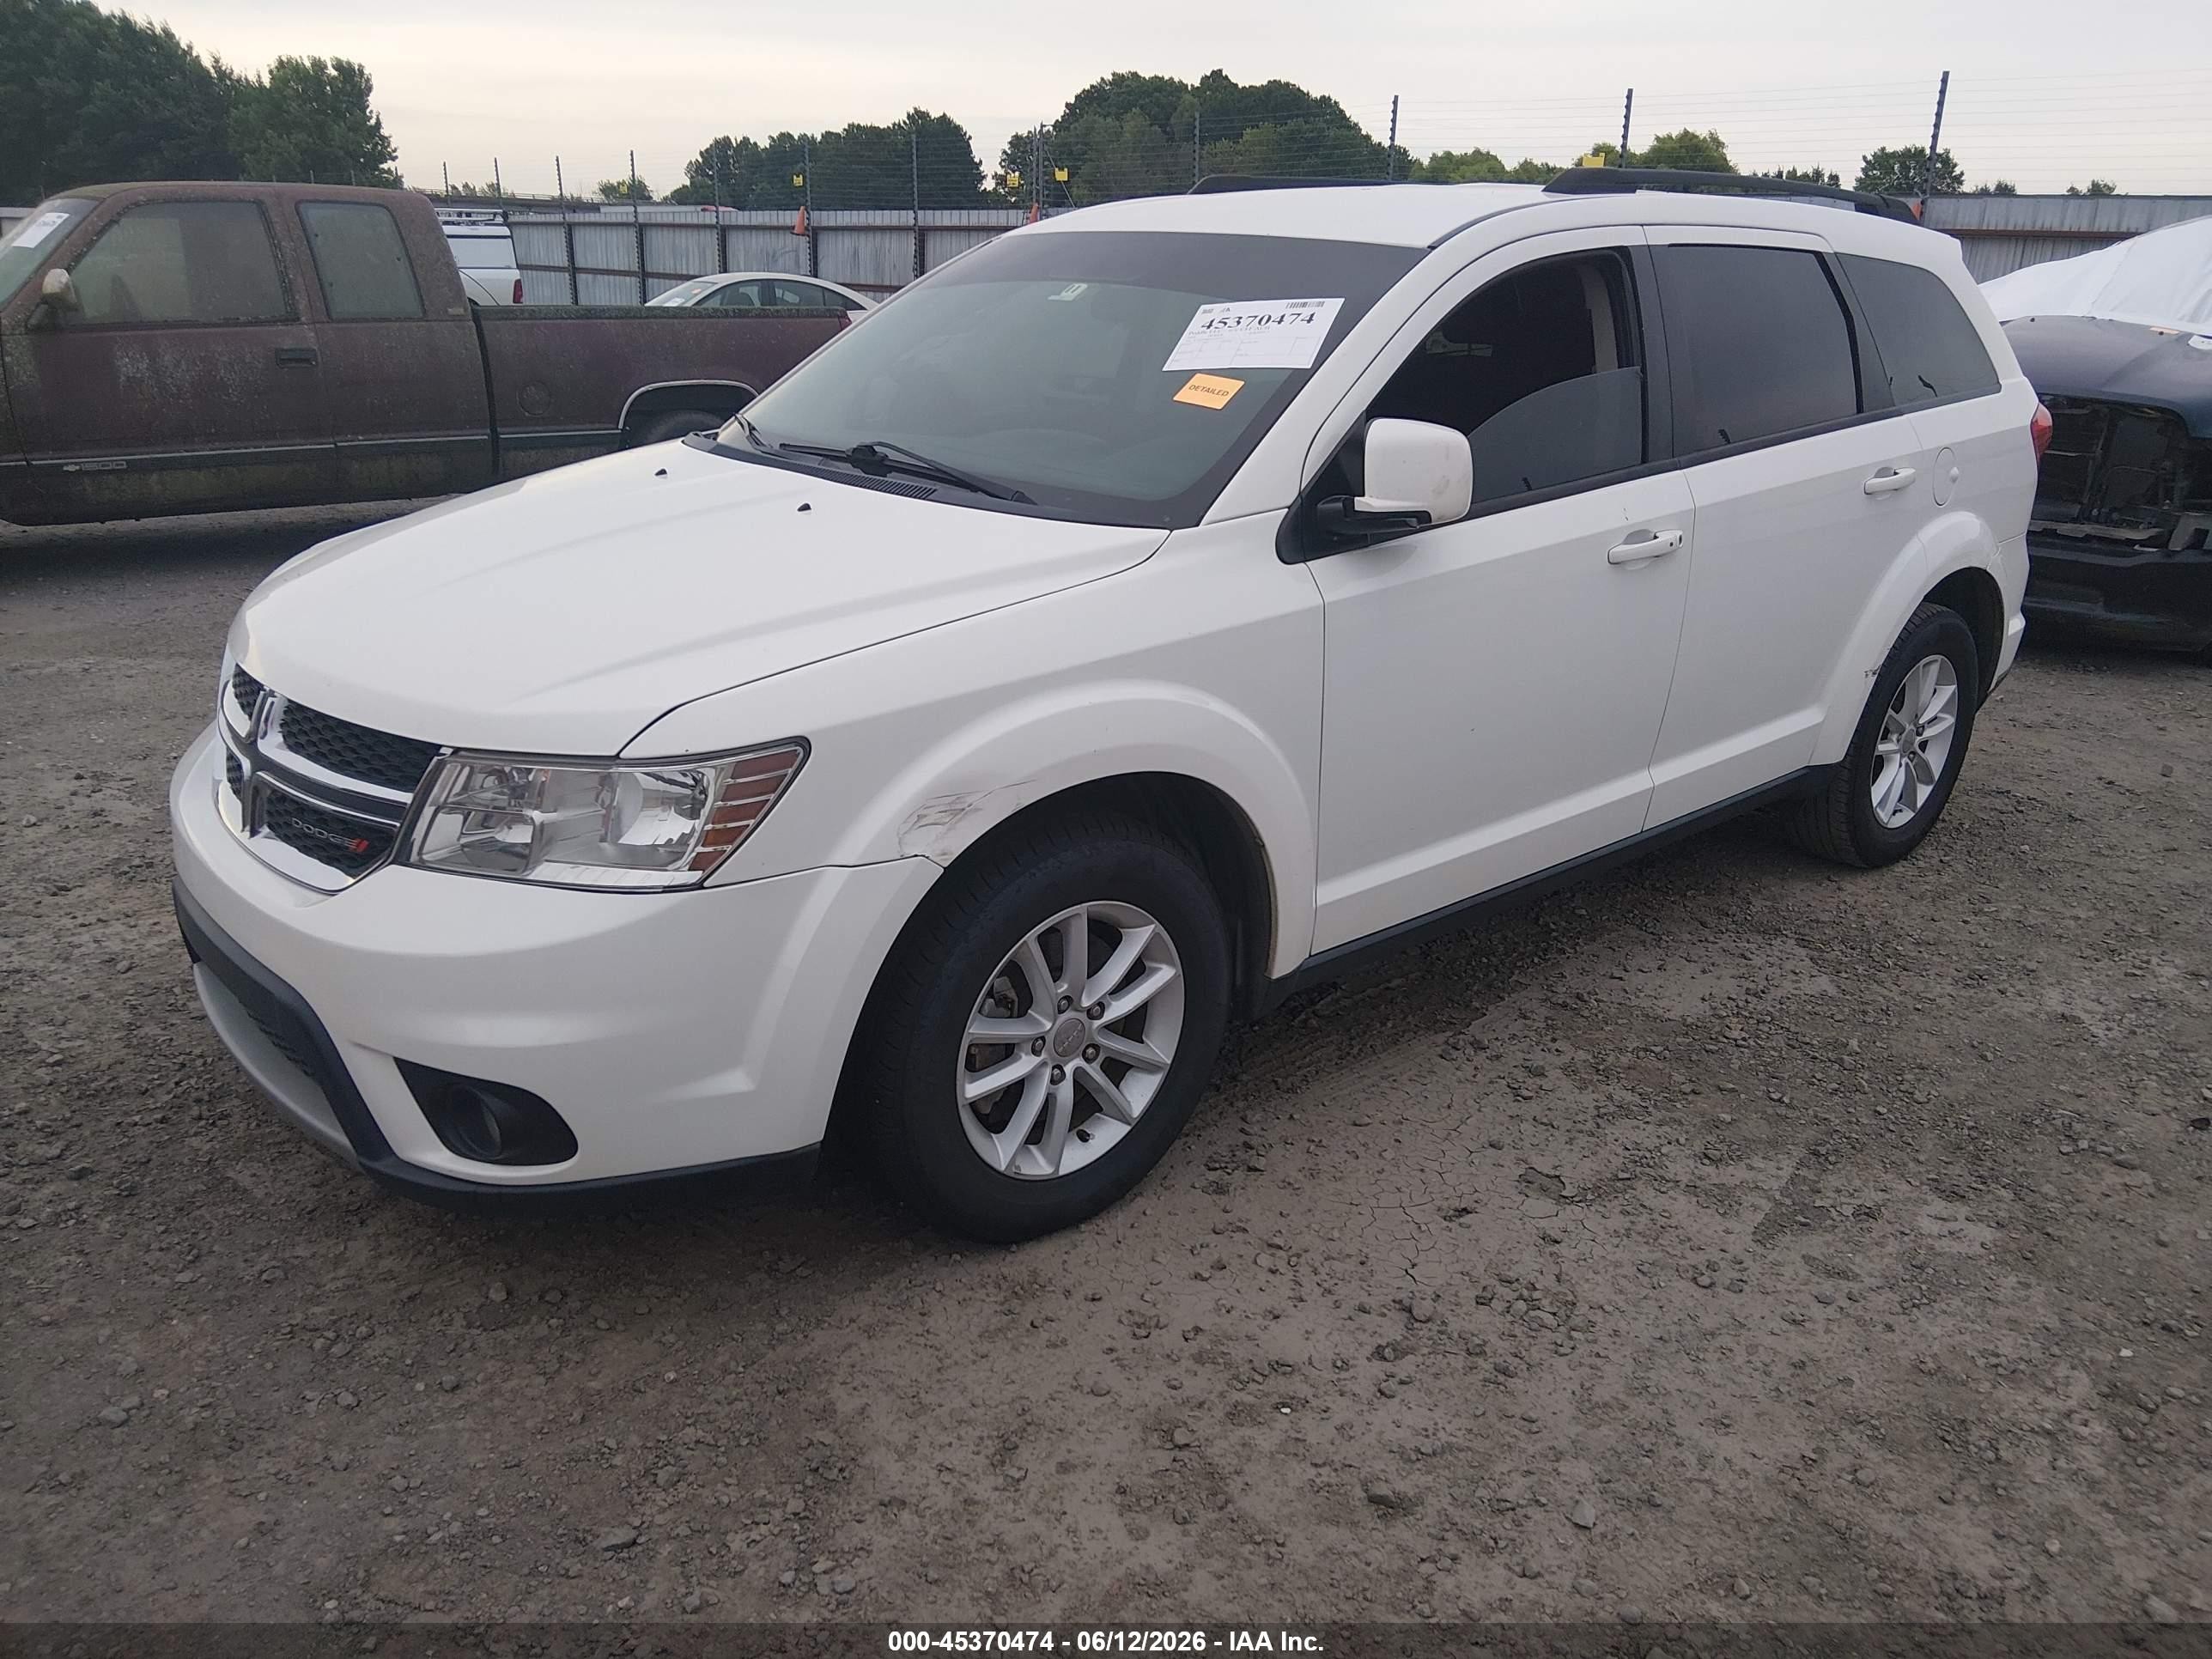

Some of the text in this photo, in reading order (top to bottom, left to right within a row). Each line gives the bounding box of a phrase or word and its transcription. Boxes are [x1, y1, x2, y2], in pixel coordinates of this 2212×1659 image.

[1200, 312, 1316, 330] 45370474
[1188, 384, 1230, 398] DETAILED
[291, 817, 359, 849] DODGE
